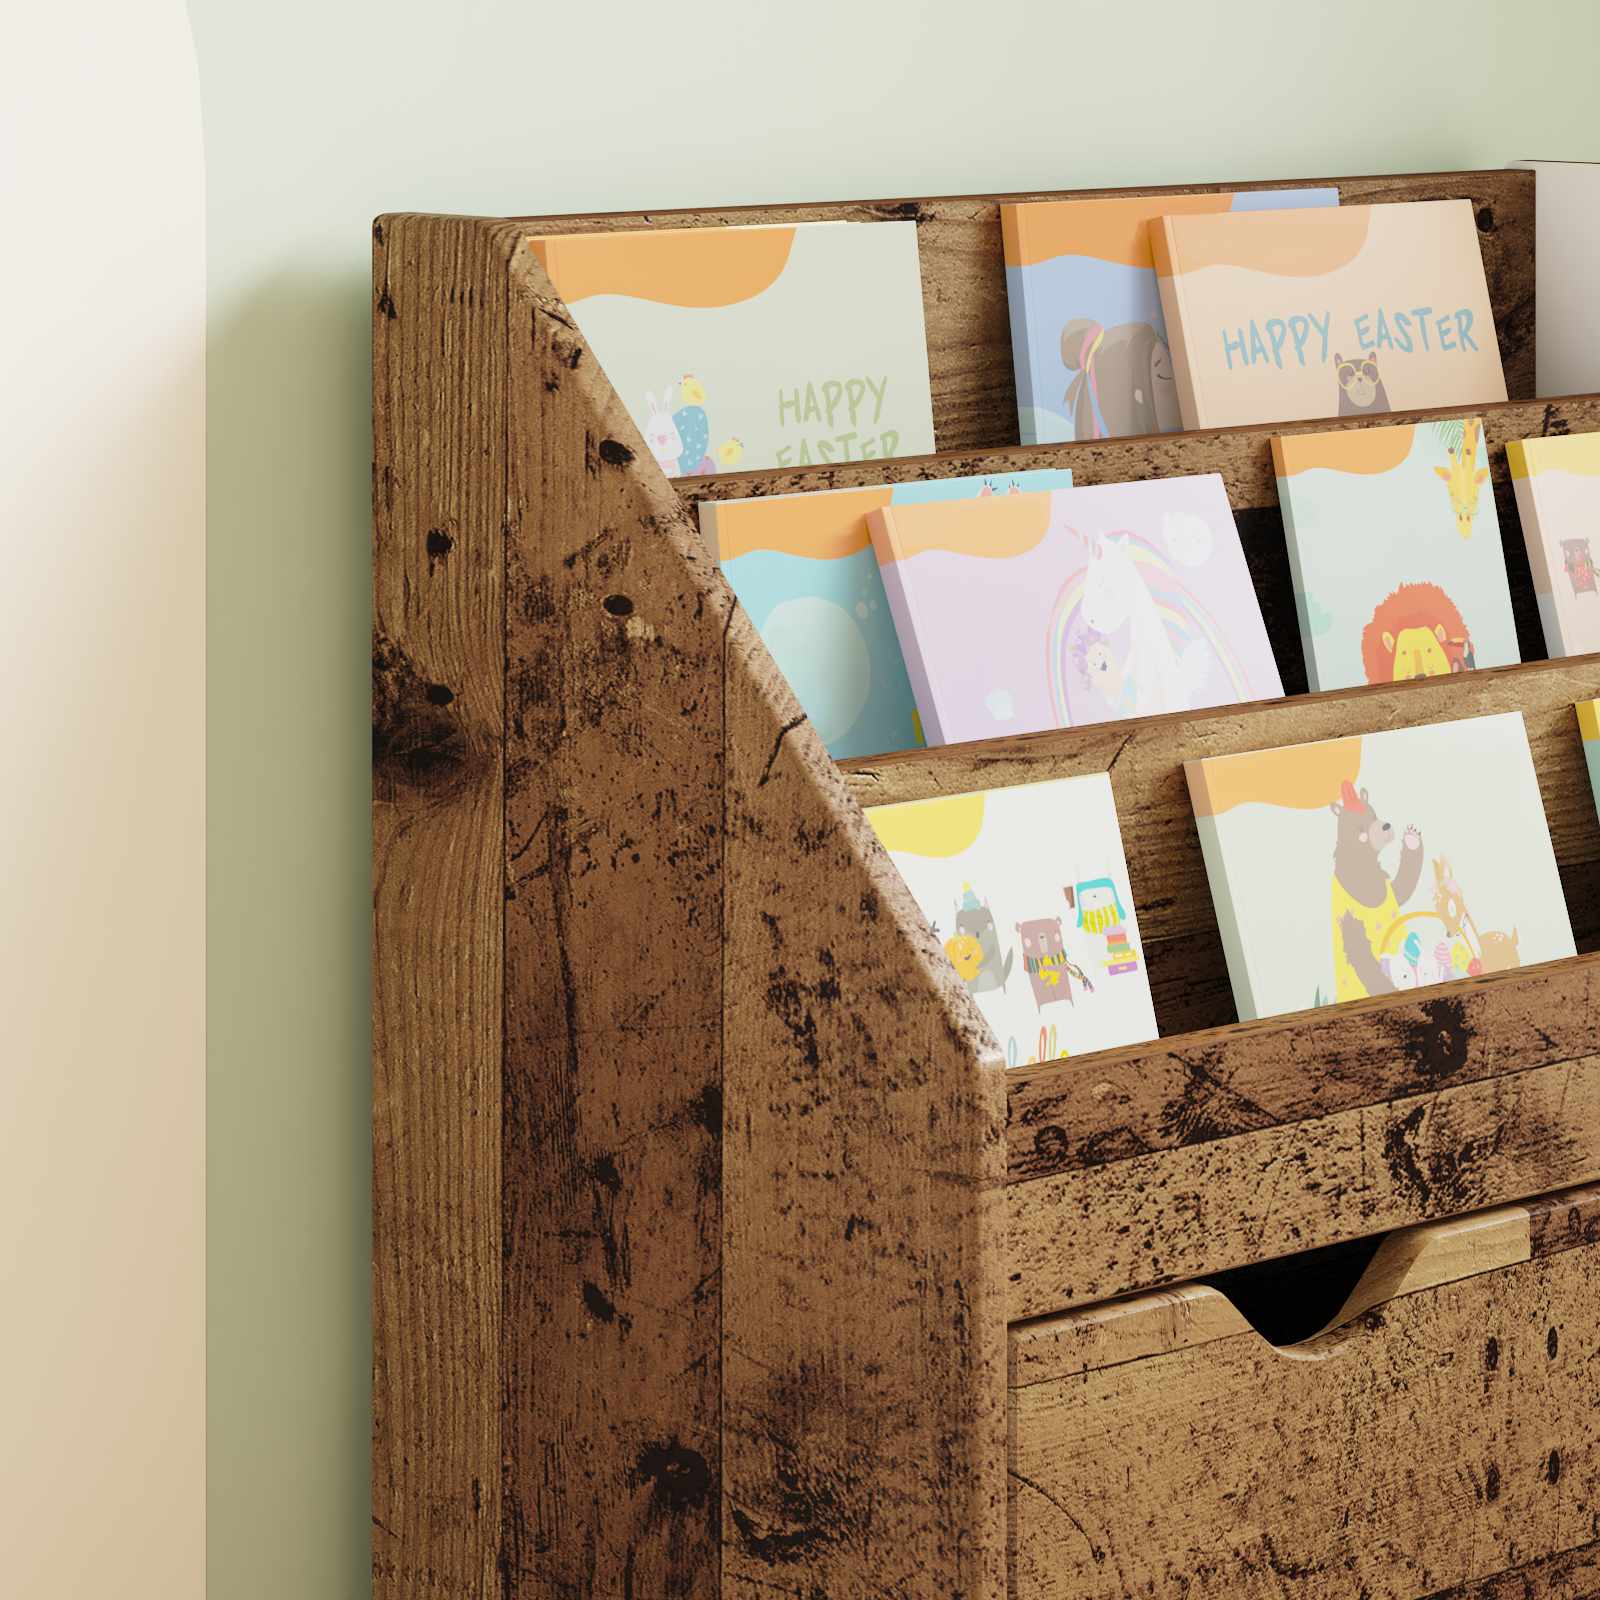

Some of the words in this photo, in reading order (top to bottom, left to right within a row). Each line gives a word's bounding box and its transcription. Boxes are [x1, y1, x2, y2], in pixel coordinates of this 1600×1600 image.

[1221, 311, 1330, 370] HAPPY
[1353, 306, 1479, 353] EASTER
[778, 375, 888, 428] HAPPY
